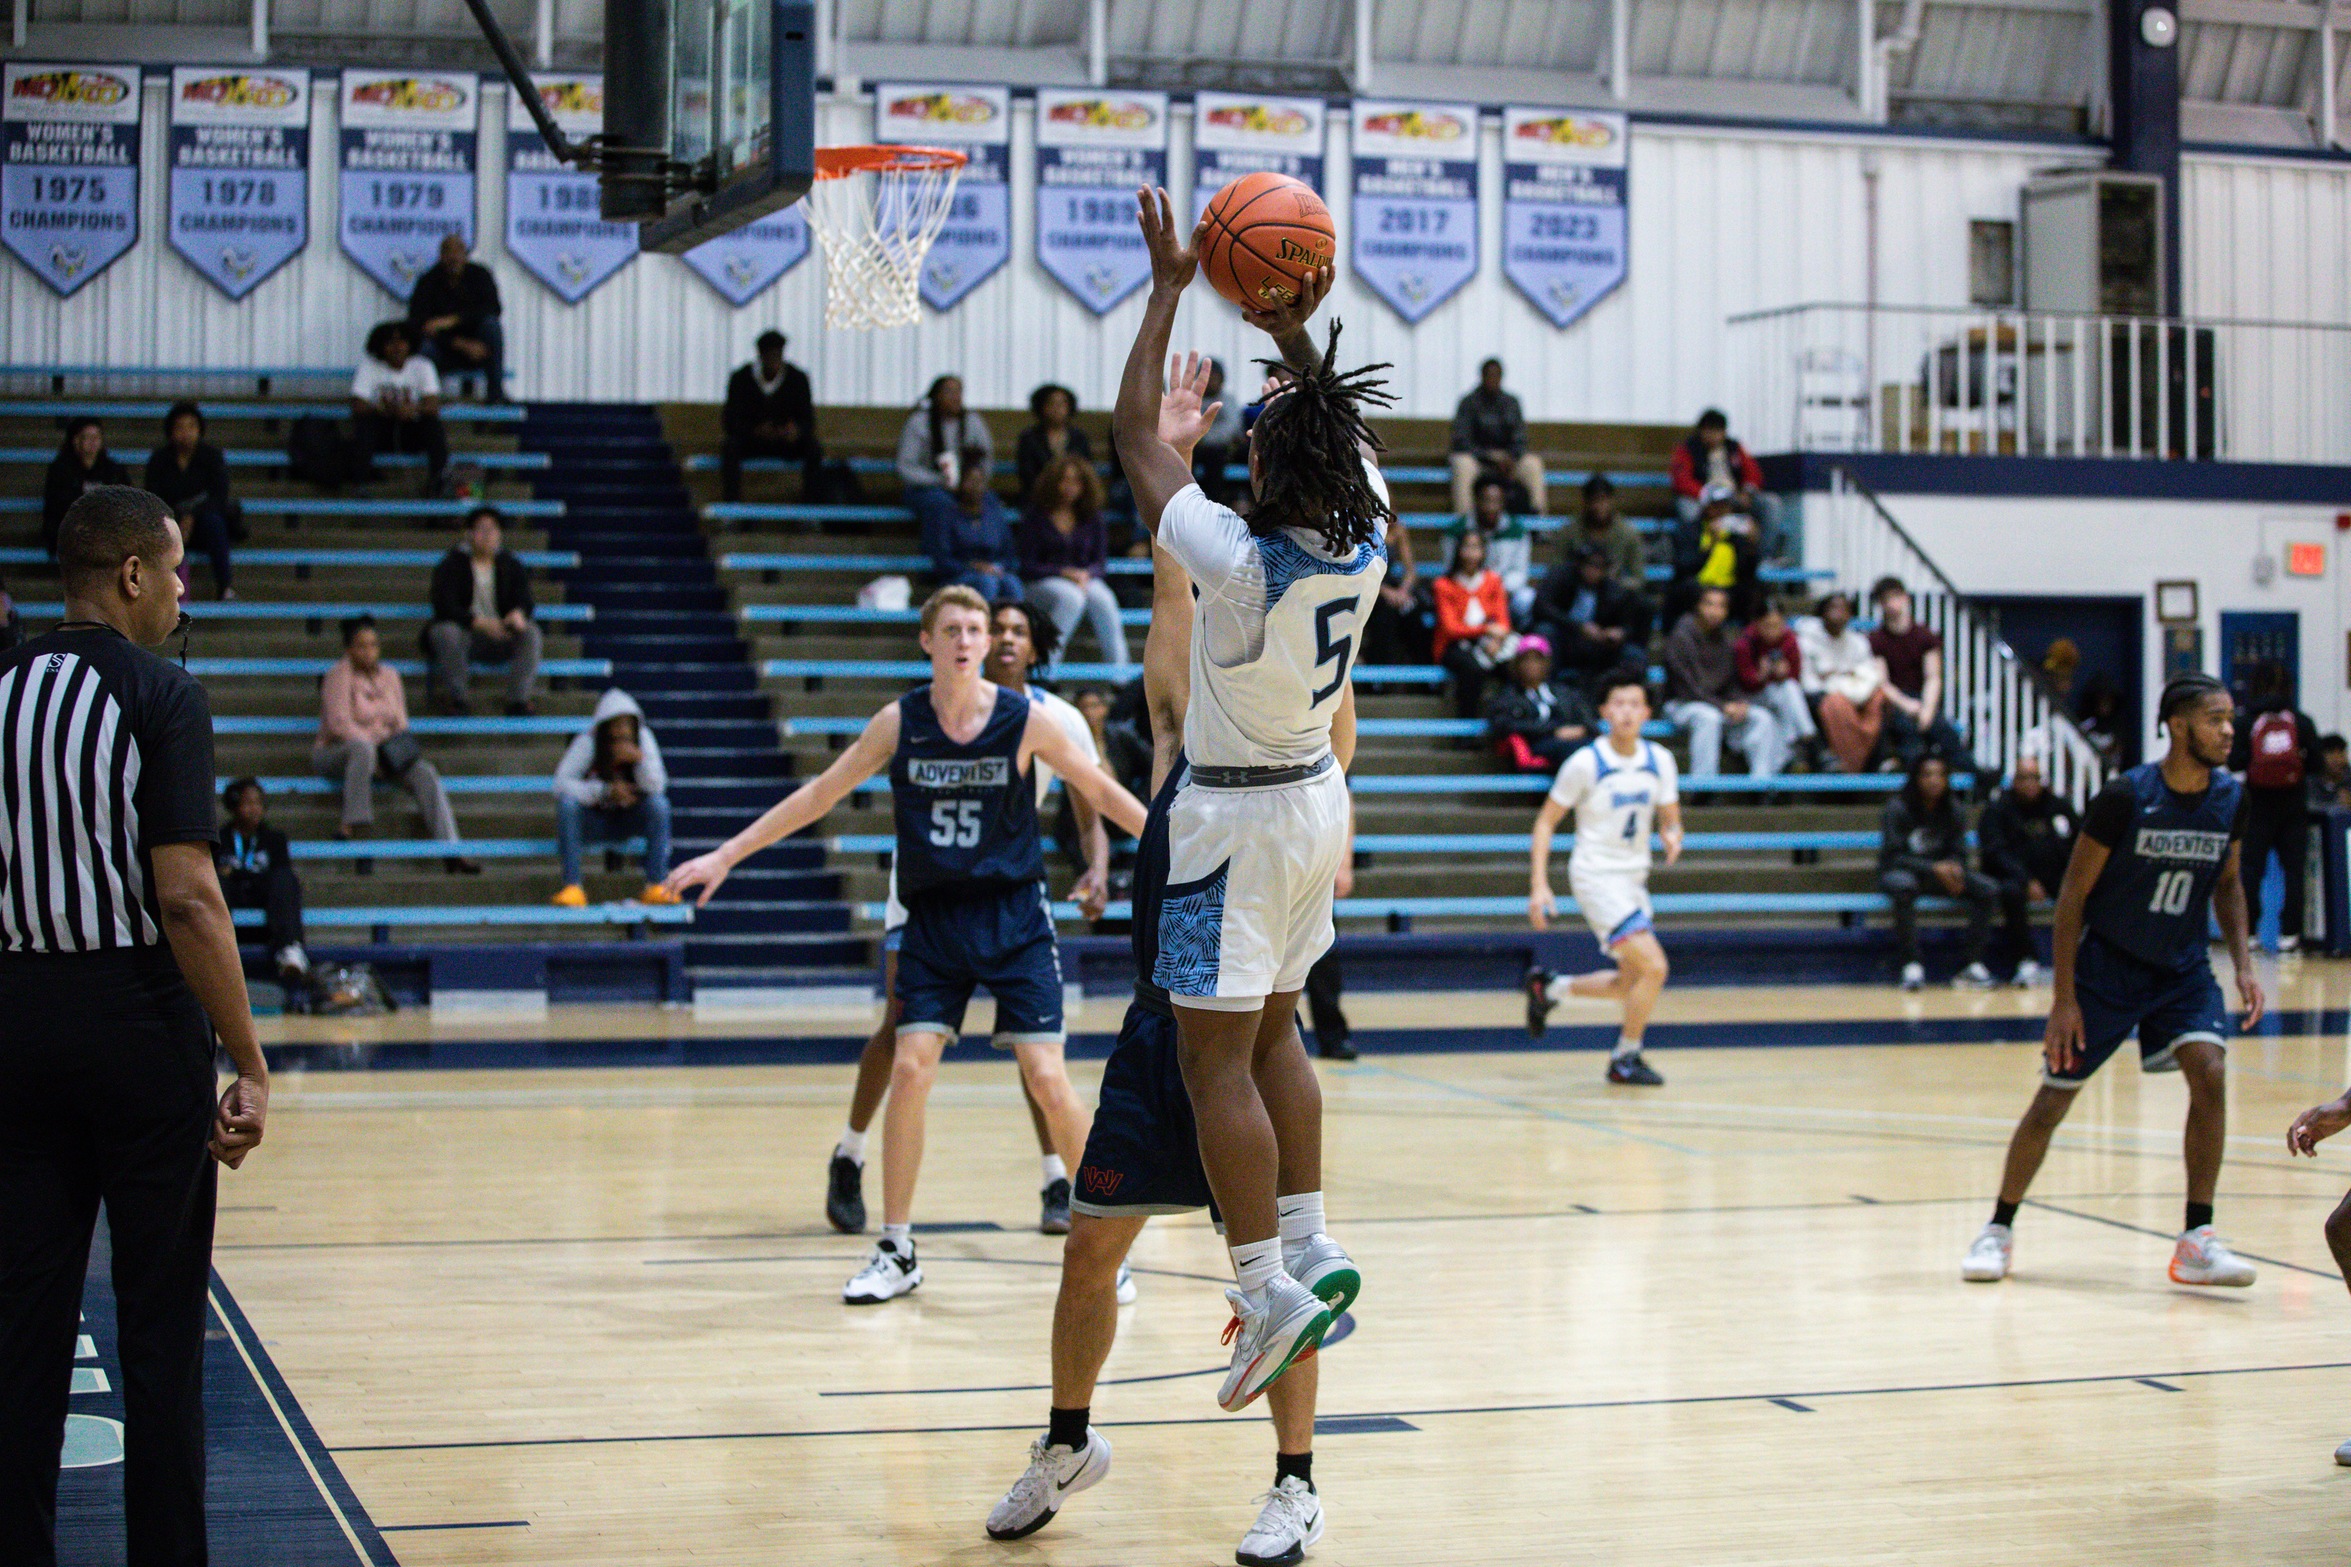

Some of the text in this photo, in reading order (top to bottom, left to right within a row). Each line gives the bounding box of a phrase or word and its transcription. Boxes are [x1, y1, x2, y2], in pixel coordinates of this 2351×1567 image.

[27, 122, 114, 142] WOMEN'S
[9, 141, 131, 165] BASKETBALL
[33, 174, 106, 202] 1975
[9, 210, 127, 231] CHAMPIONS
[1309, 594, 1360, 710] 5
[915, 758, 1003, 783] ADVENTIST
[929, 799, 983, 848] 55
[1620, 811, 1637, 843] 4
[2148, 870, 2194, 915] 10
